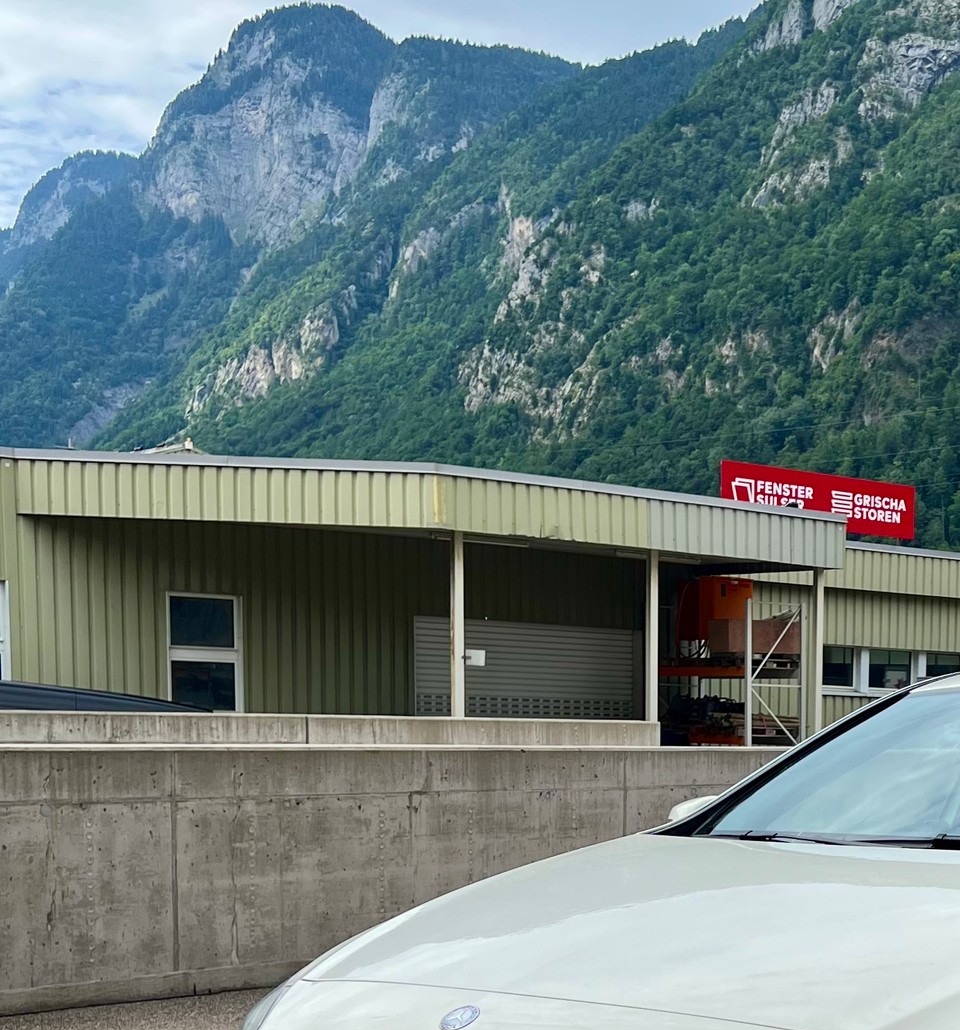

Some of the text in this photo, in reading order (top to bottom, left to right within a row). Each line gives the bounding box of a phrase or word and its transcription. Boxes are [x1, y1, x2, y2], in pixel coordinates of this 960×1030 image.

[756, 480, 814, 500] FENSTER
[853, 493, 907, 512] GRISCHA
[853, 507, 901, 524] STOREN
